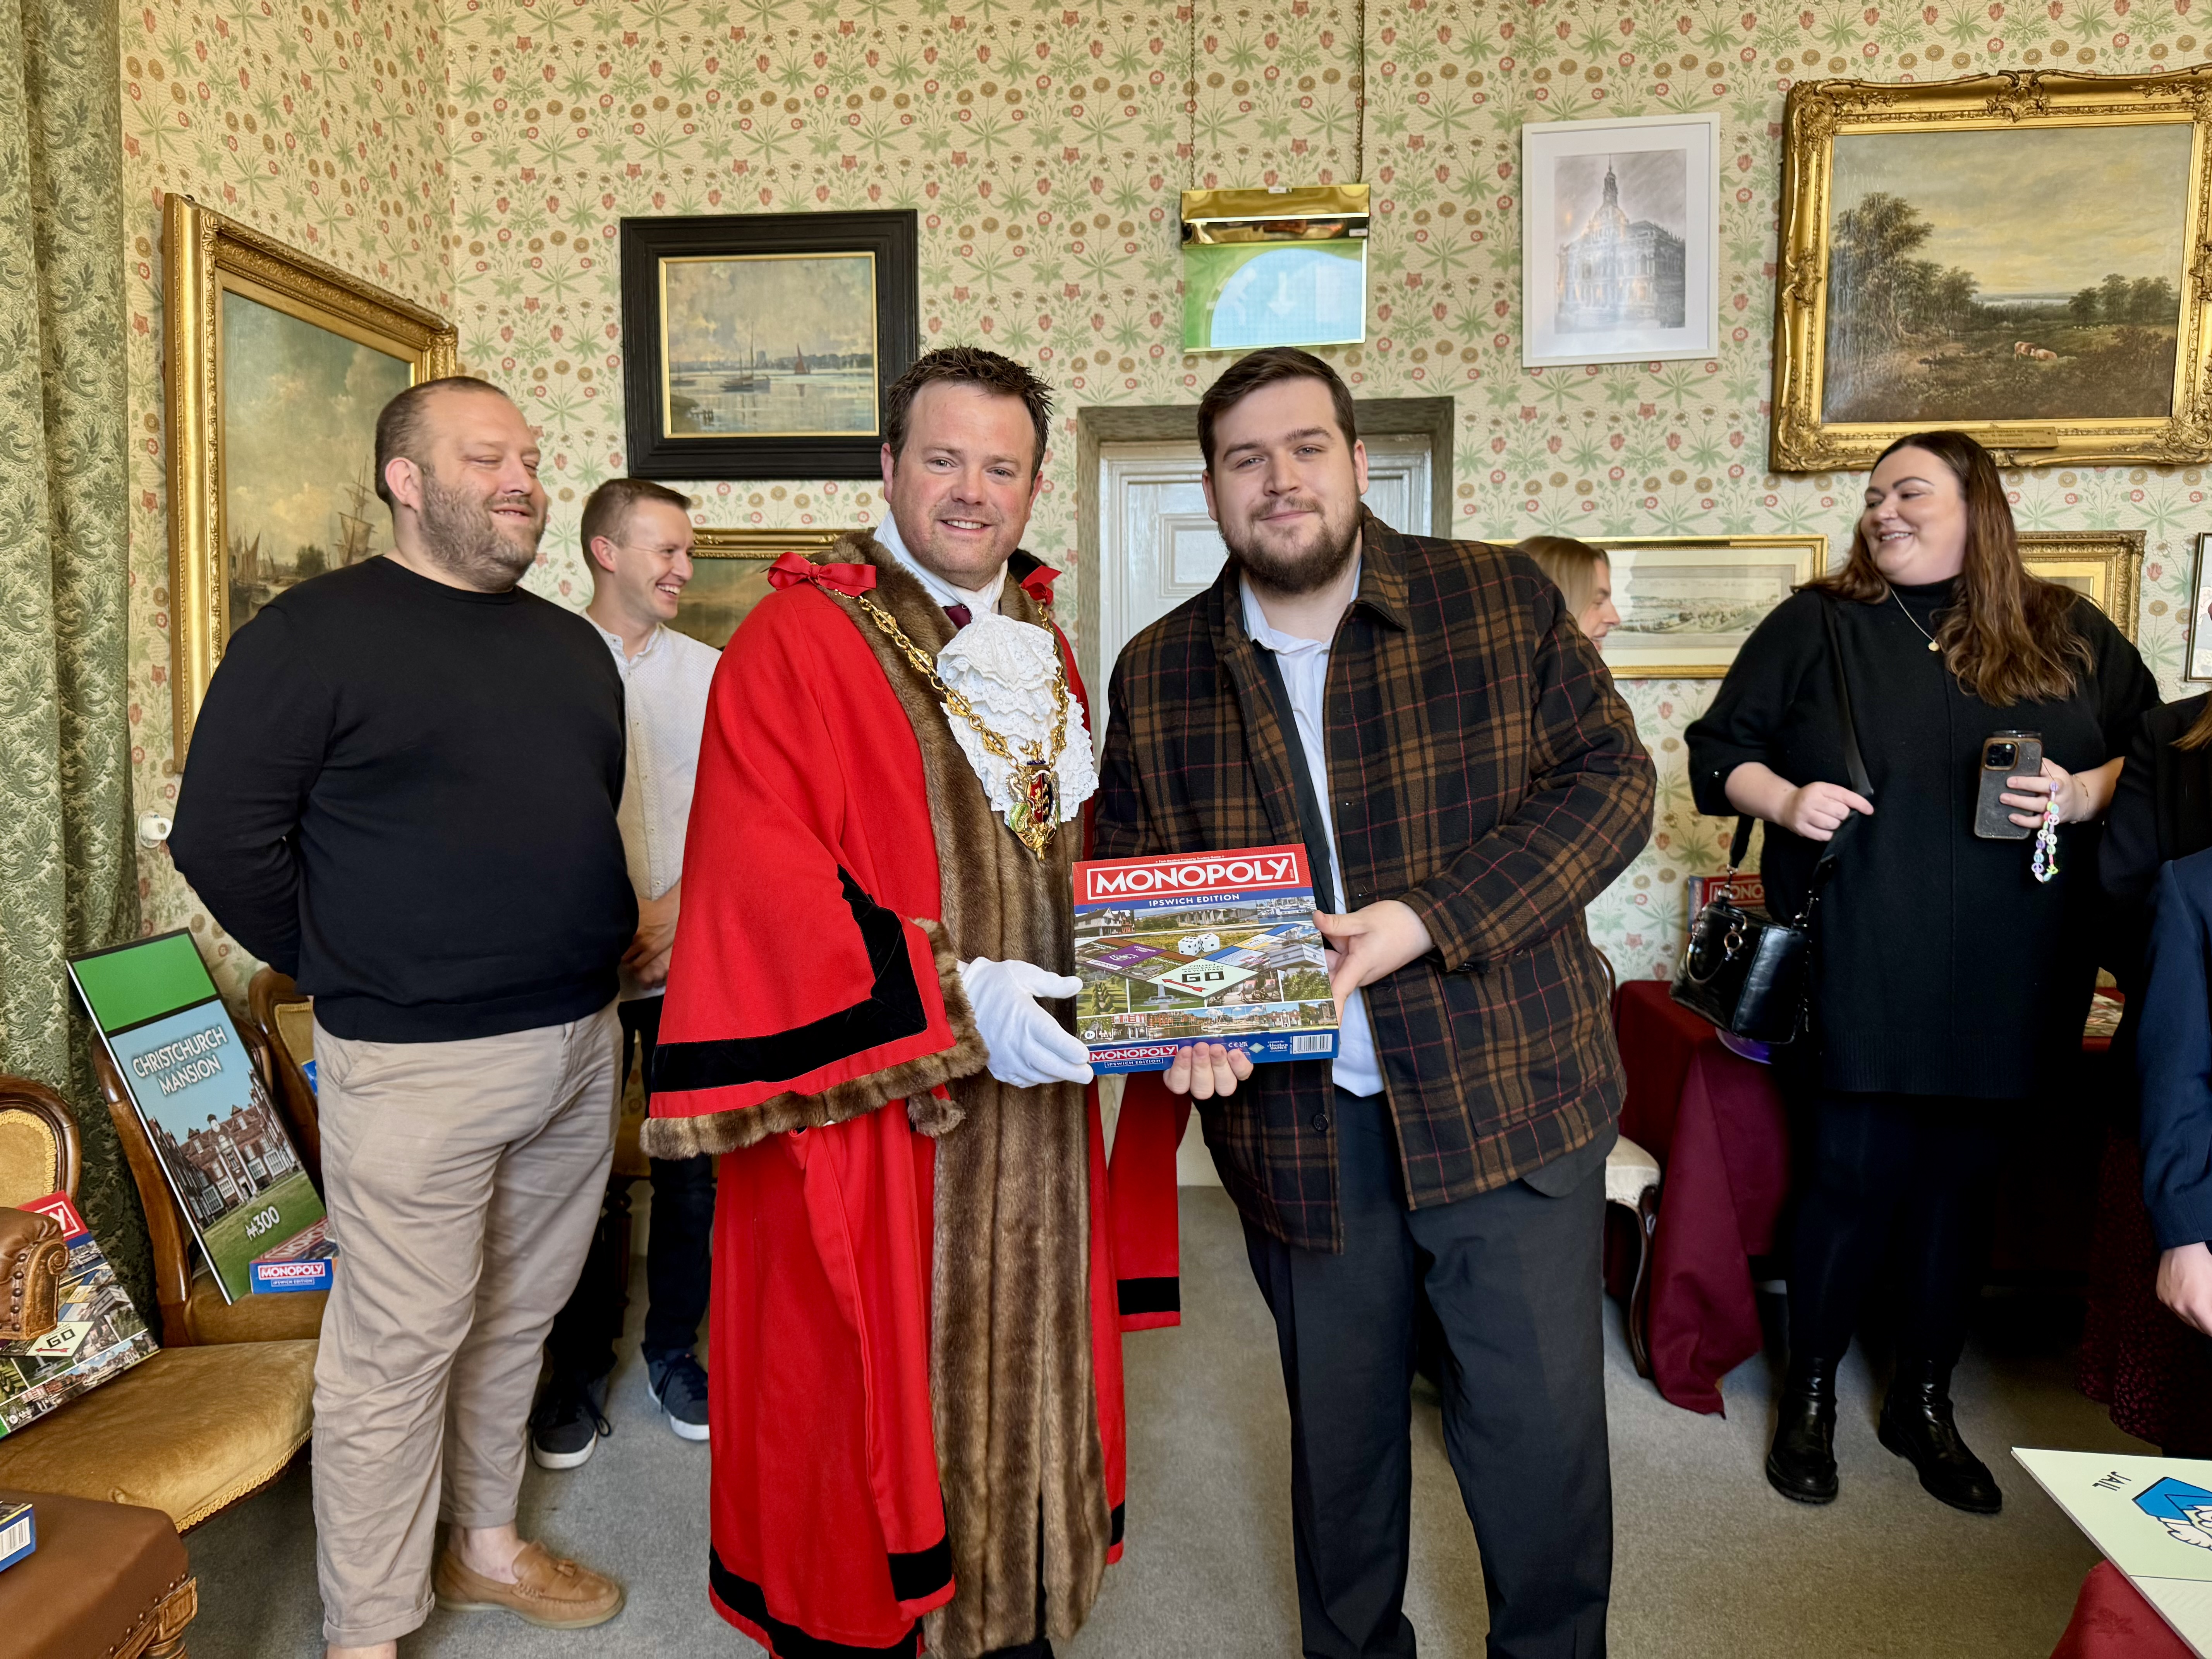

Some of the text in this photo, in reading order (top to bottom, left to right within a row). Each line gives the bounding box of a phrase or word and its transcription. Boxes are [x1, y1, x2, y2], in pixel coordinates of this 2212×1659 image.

[1096, 858, 1289, 894] MONOPOLY
[1149, 894, 1240, 907] IPSWICH EDITION
[1182, 971, 1224, 983] GO
[133, 1026, 228, 1077] CHRISTCHURCH
[1092, 1046, 1176, 1061] MONOPOLY
[158, 1054, 222, 1096] MANSION
[261, 1265, 322, 1278] MONOPOLY
[46, 1329, 76, 1348] GO
[2092, 1471, 2132, 1491] JAIL
